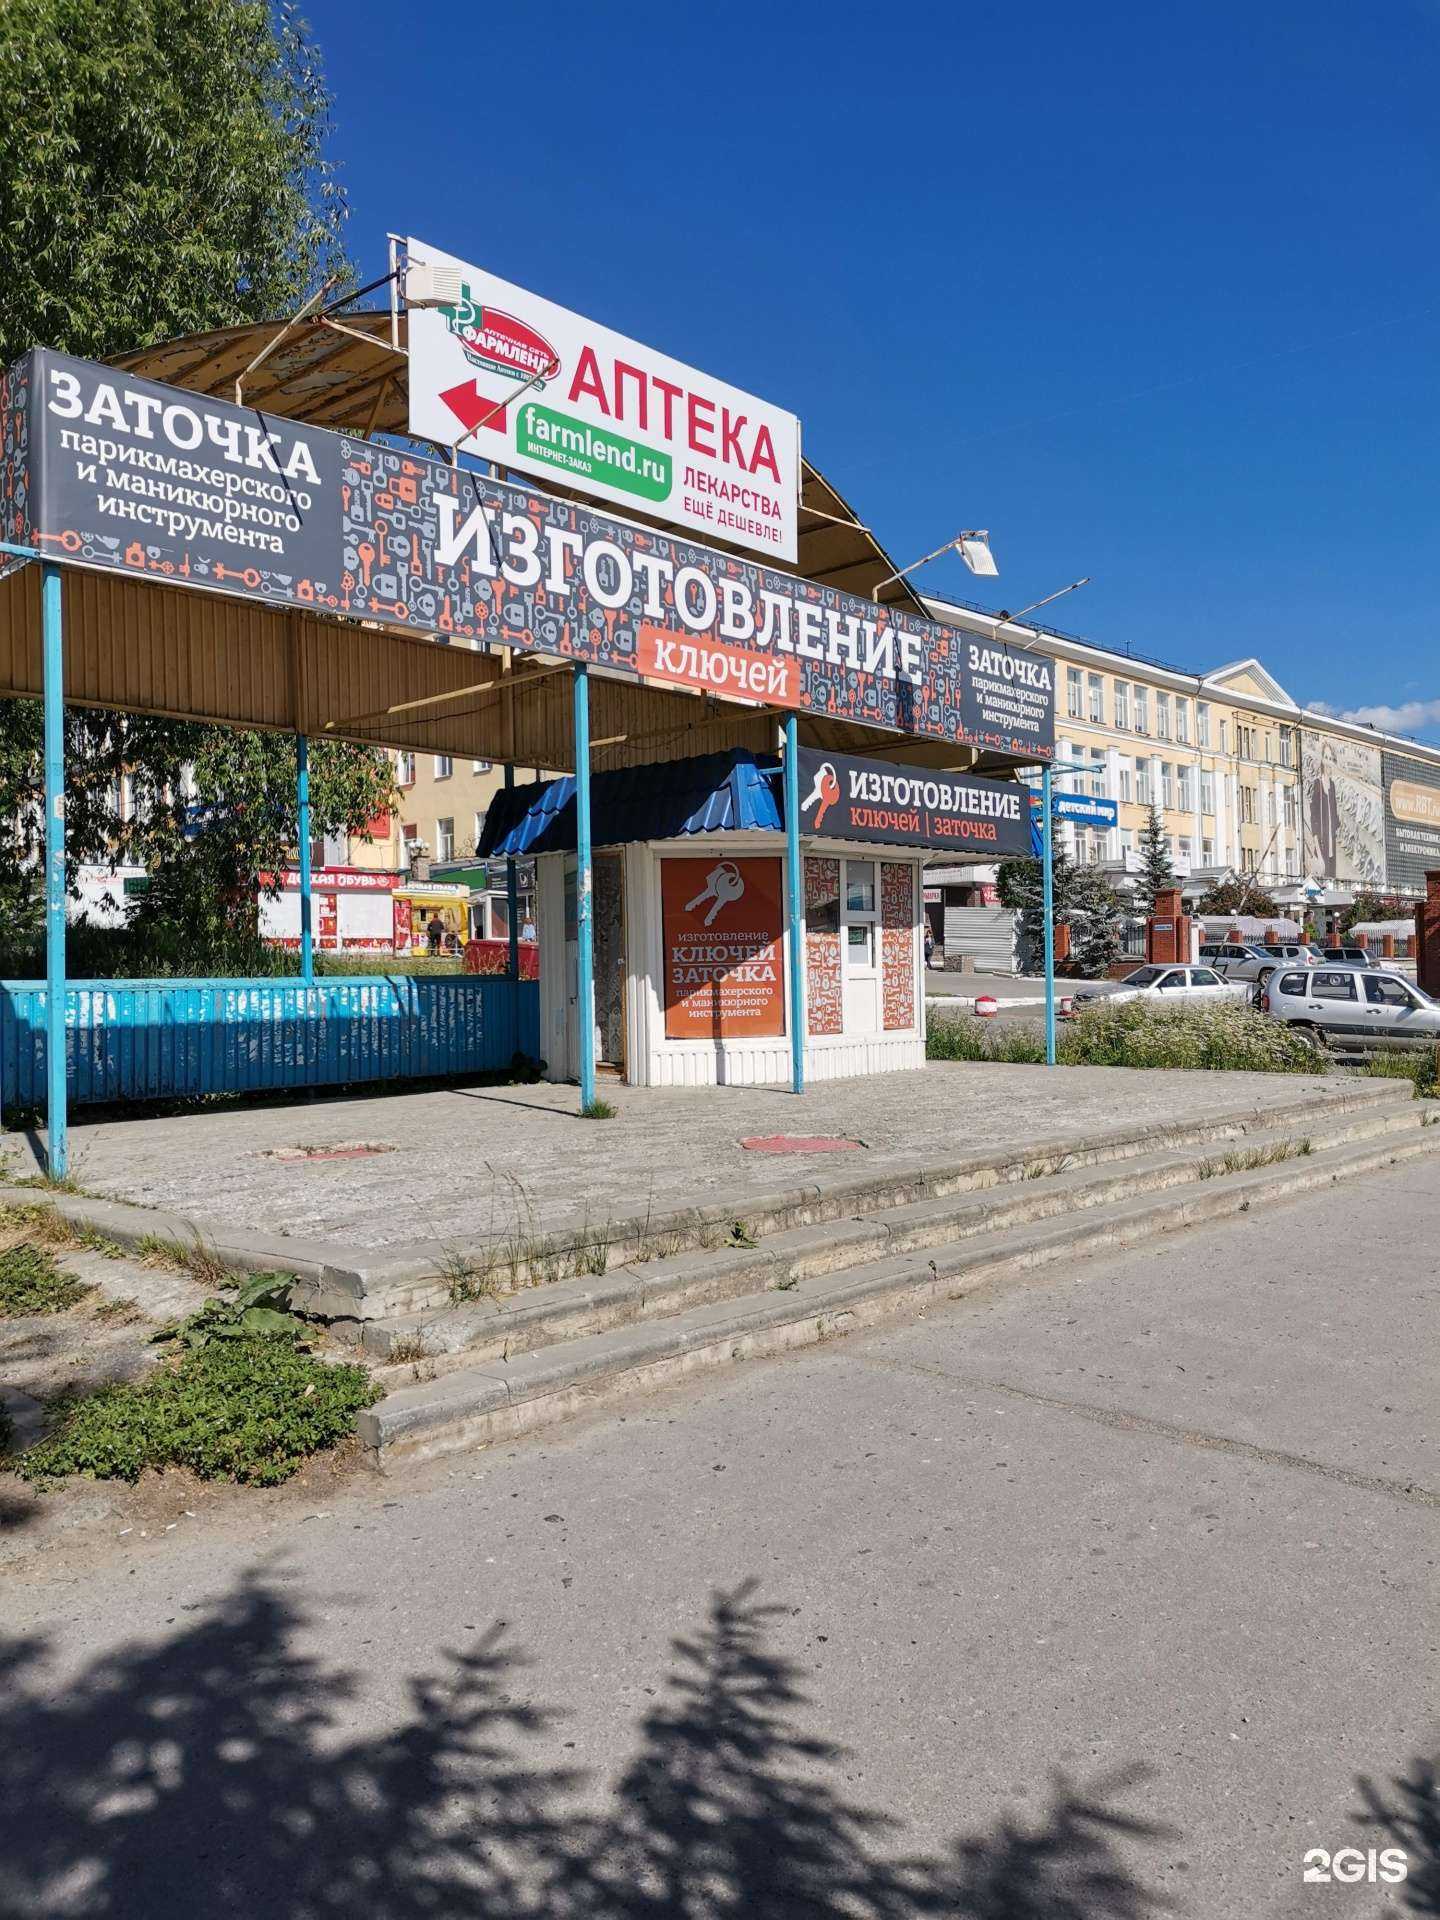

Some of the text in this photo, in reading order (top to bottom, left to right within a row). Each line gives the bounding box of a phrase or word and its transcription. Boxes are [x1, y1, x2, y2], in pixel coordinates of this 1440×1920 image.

[48, 369, 322, 485] ЗАТОЧКА
[568, 345, 782, 485] АПТЕКА
[525, 406, 665, 484] farmlend.ru
[527, 441, 592, 473] ИНТЕРНЕТ-ЗАКАЗ
[60, 429, 312, 511] парикмахерского
[76, 461, 301, 533] и маникюрного
[684, 466, 782, 520] ЛЕКАРСТВА
[97, 494, 285, 554] инструмента
[684, 496, 783, 544] ЕЩЁ ДЕШЕВЛЕ!
[433, 491, 923, 686] ИЗГОТОВЛЕНИЕ
[654, 637, 789, 697] ключей
[968, 645, 1052, 690] ЗАТОЧКА
[972, 676, 1049, 706] парикмахерского
[976, 693, 1045, 719] и маникюрного
[982, 709, 1040, 732] инструмента
[849, 770, 1021, 821] ИЗГОТОВЛЕНИЕ
[851, 807, 997, 841] ключей заточка
[672, 940, 776, 962] КЛЮЧЕЙ
[678, 931, 769, 942] изготовление
[672, 965, 776, 983] ЗАТОЧКА
[676, 987, 774, 999] парикмахерского
[688, 1008, 761, 1020] инструмента
[692, 998, 768, 1009] маникюрного
